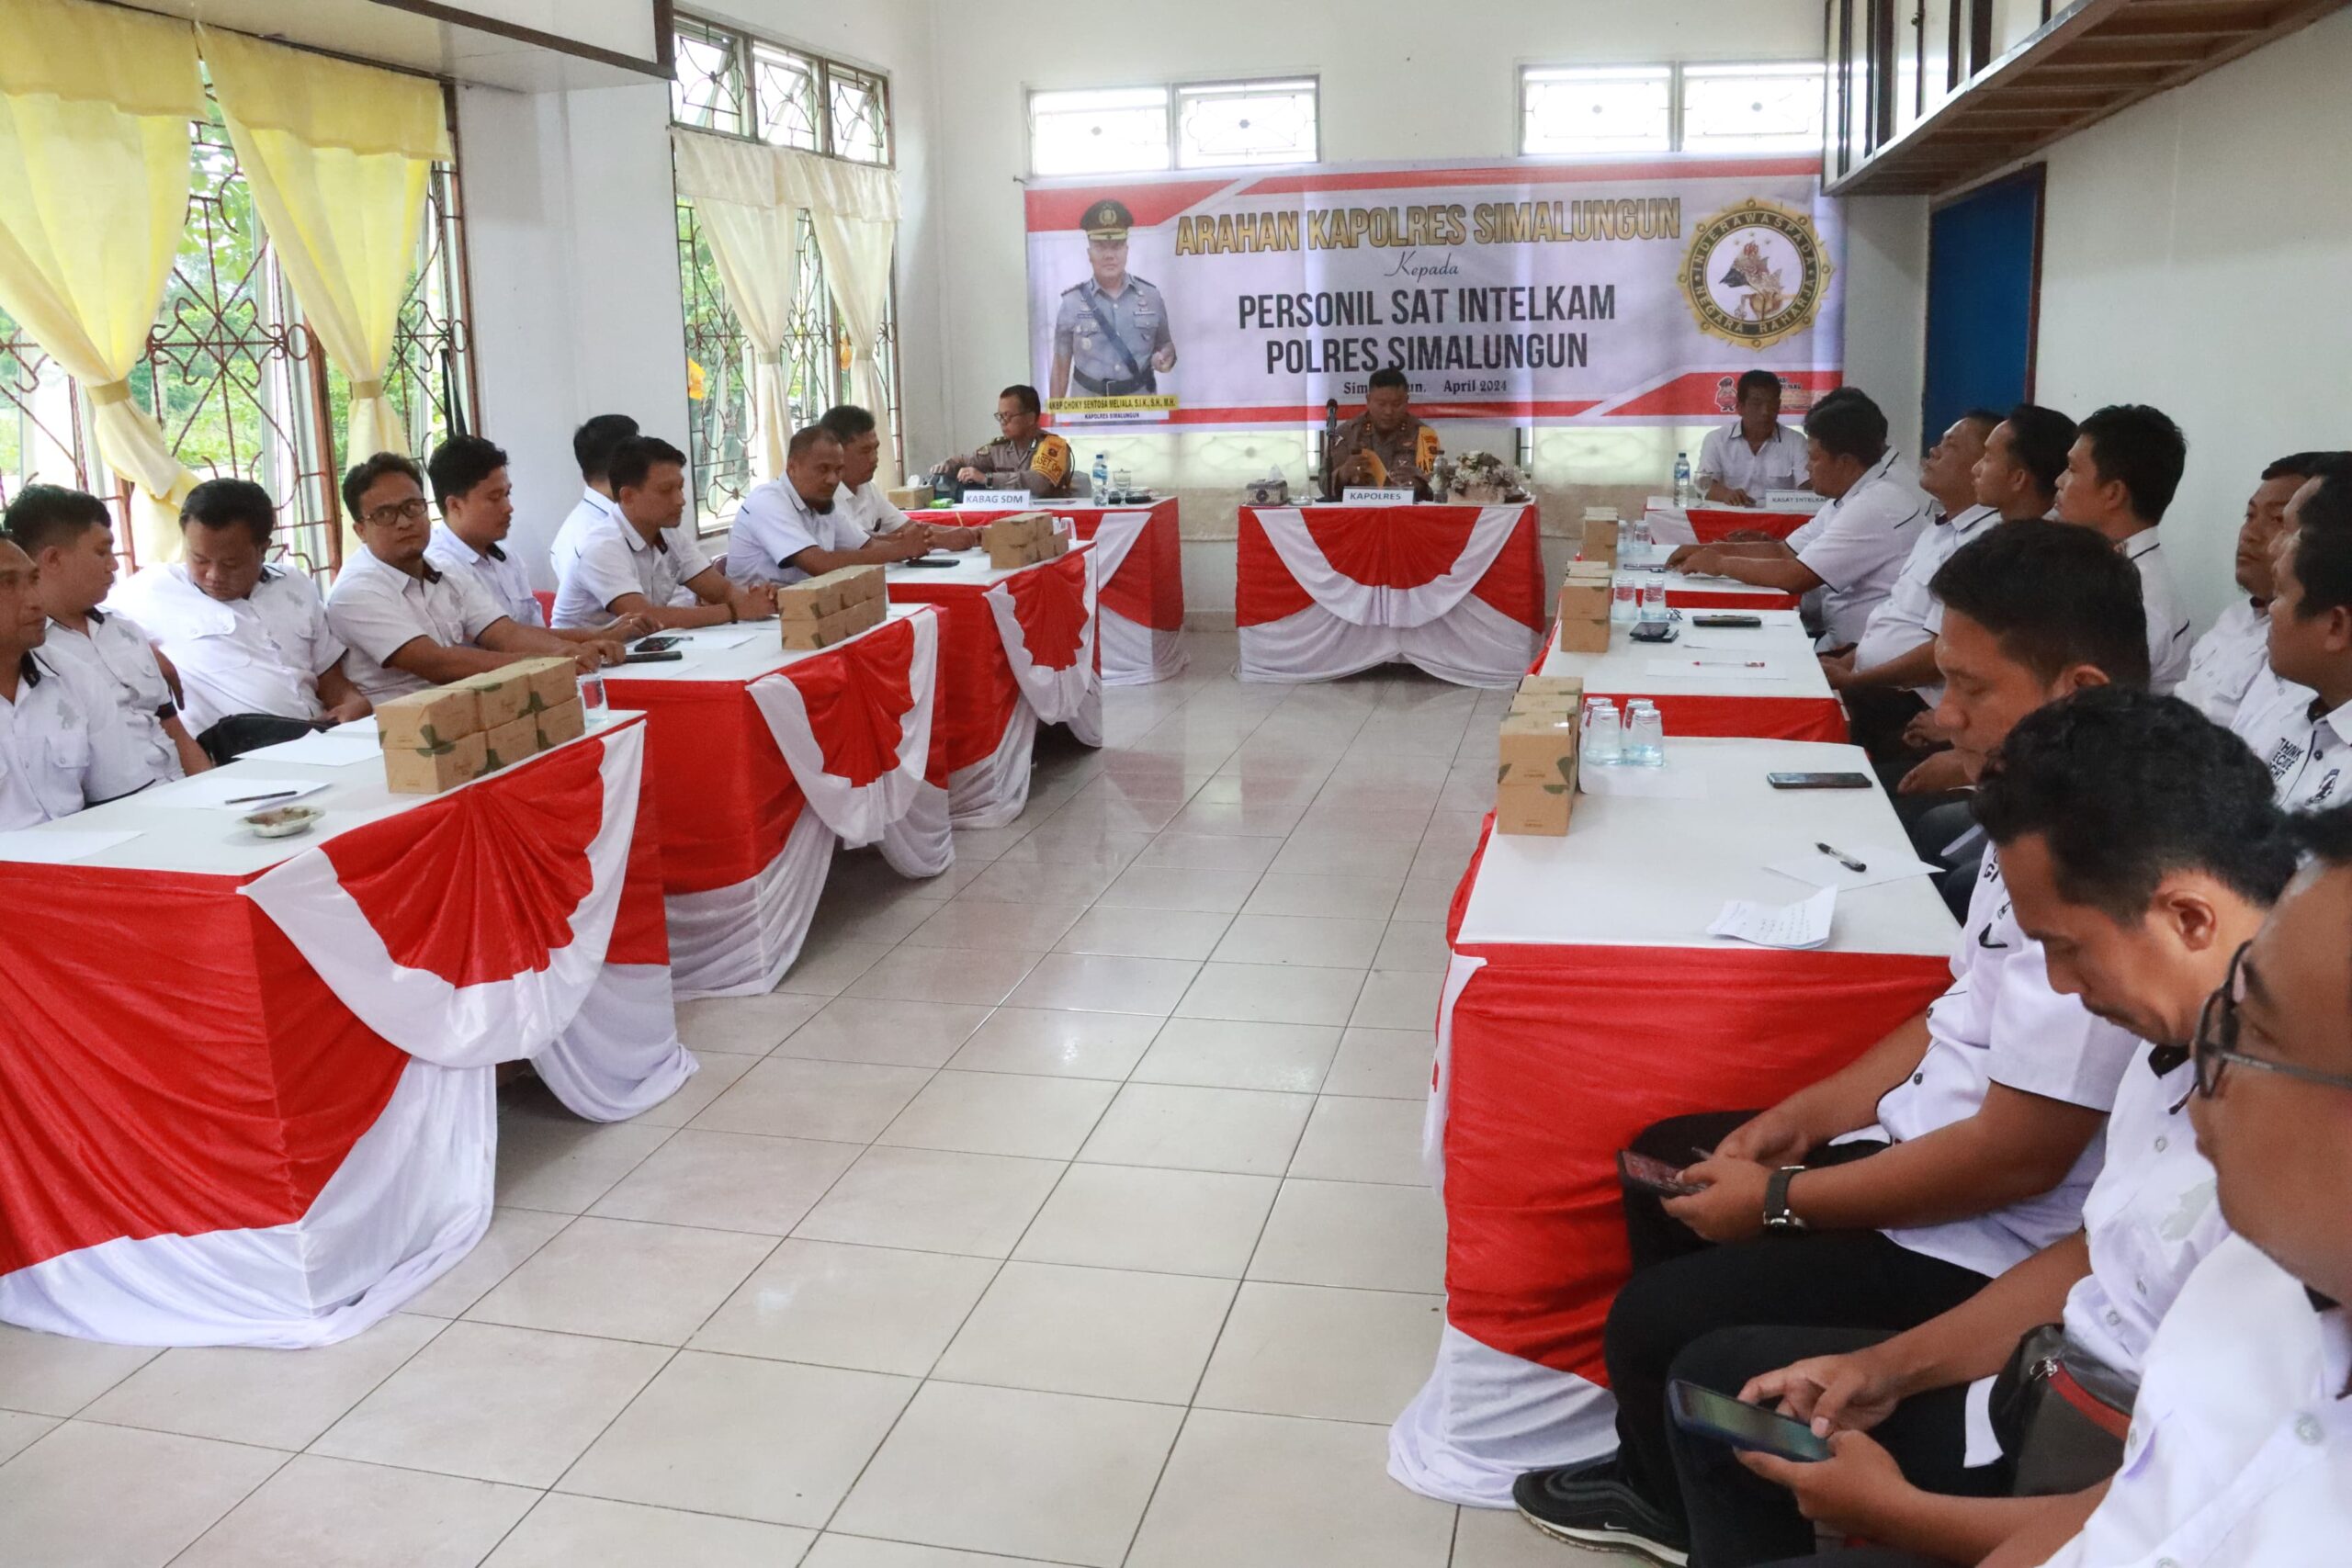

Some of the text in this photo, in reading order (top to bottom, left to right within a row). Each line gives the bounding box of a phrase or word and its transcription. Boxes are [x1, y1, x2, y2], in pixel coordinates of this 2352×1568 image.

[1175, 197, 1680, 255] ARAHAN KAPOLRES SIMALUNGUN
[1384, 250, 1459, 283] Kepada
[1238, 285, 1615, 330] PERSONIL SAT INTELKAM
[1694, 277, 1816, 333] NEGARA RAHARJA
[1266, 333, 1588, 375] POLRES SIMALUNGUN
[1443, 379, 1476, 397] April
[1479, 379, 1508, 393] 2024
[1064, 400, 1082, 410] CHOKY
[1084, 399, 1108, 409] SENTOSA
[966, 494, 1023, 504] KABAG SDM
[1350, 491, 1401, 501] KAPOLRES
[2278, 738, 2305, 761] THINK
